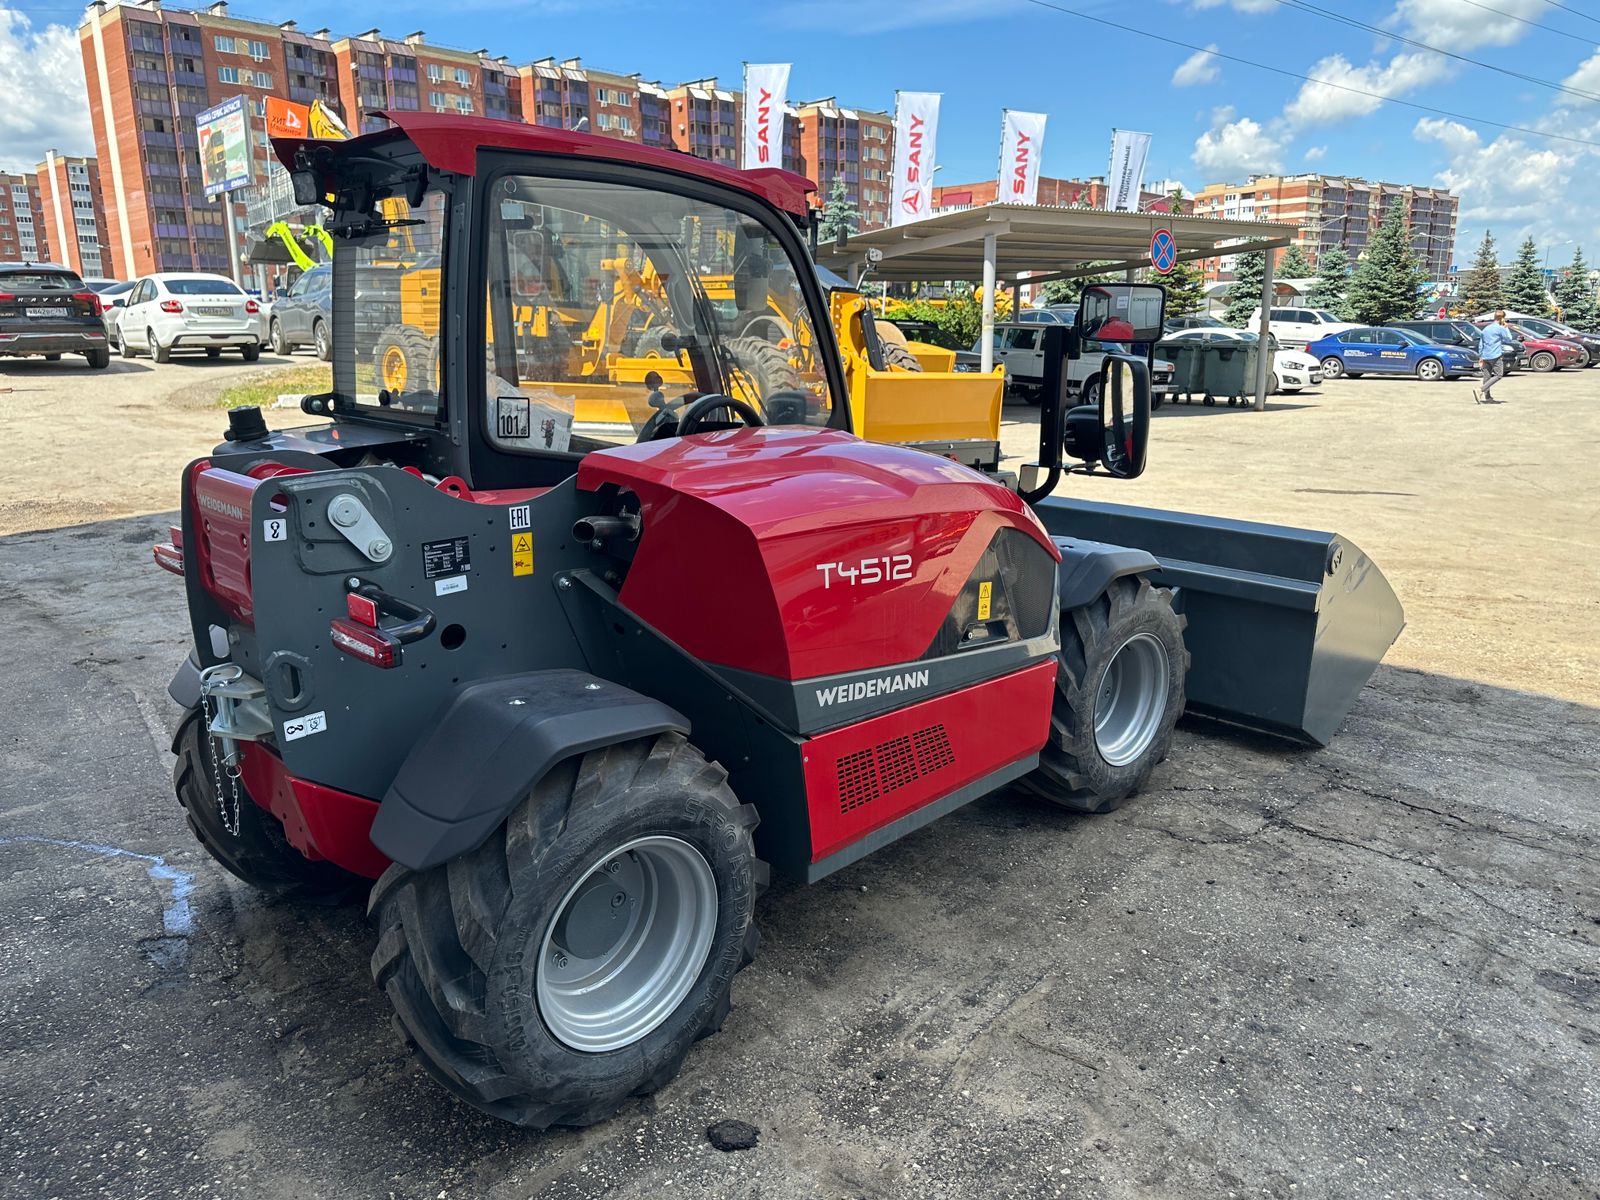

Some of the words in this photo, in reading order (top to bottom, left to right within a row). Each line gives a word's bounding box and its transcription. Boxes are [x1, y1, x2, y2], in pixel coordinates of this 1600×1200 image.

[758, 87, 771, 163] SANY
[908, 113, 924, 183] SANY
[1013, 130, 1030, 194] SANY
[501, 415, 519, 434] 101
[200, 494, 243, 520] WEIDEMANN
[511, 507, 529, 527] EAC
[816, 554, 913, 589] T4512
[815, 669, 930, 708] WEIDEMANN
